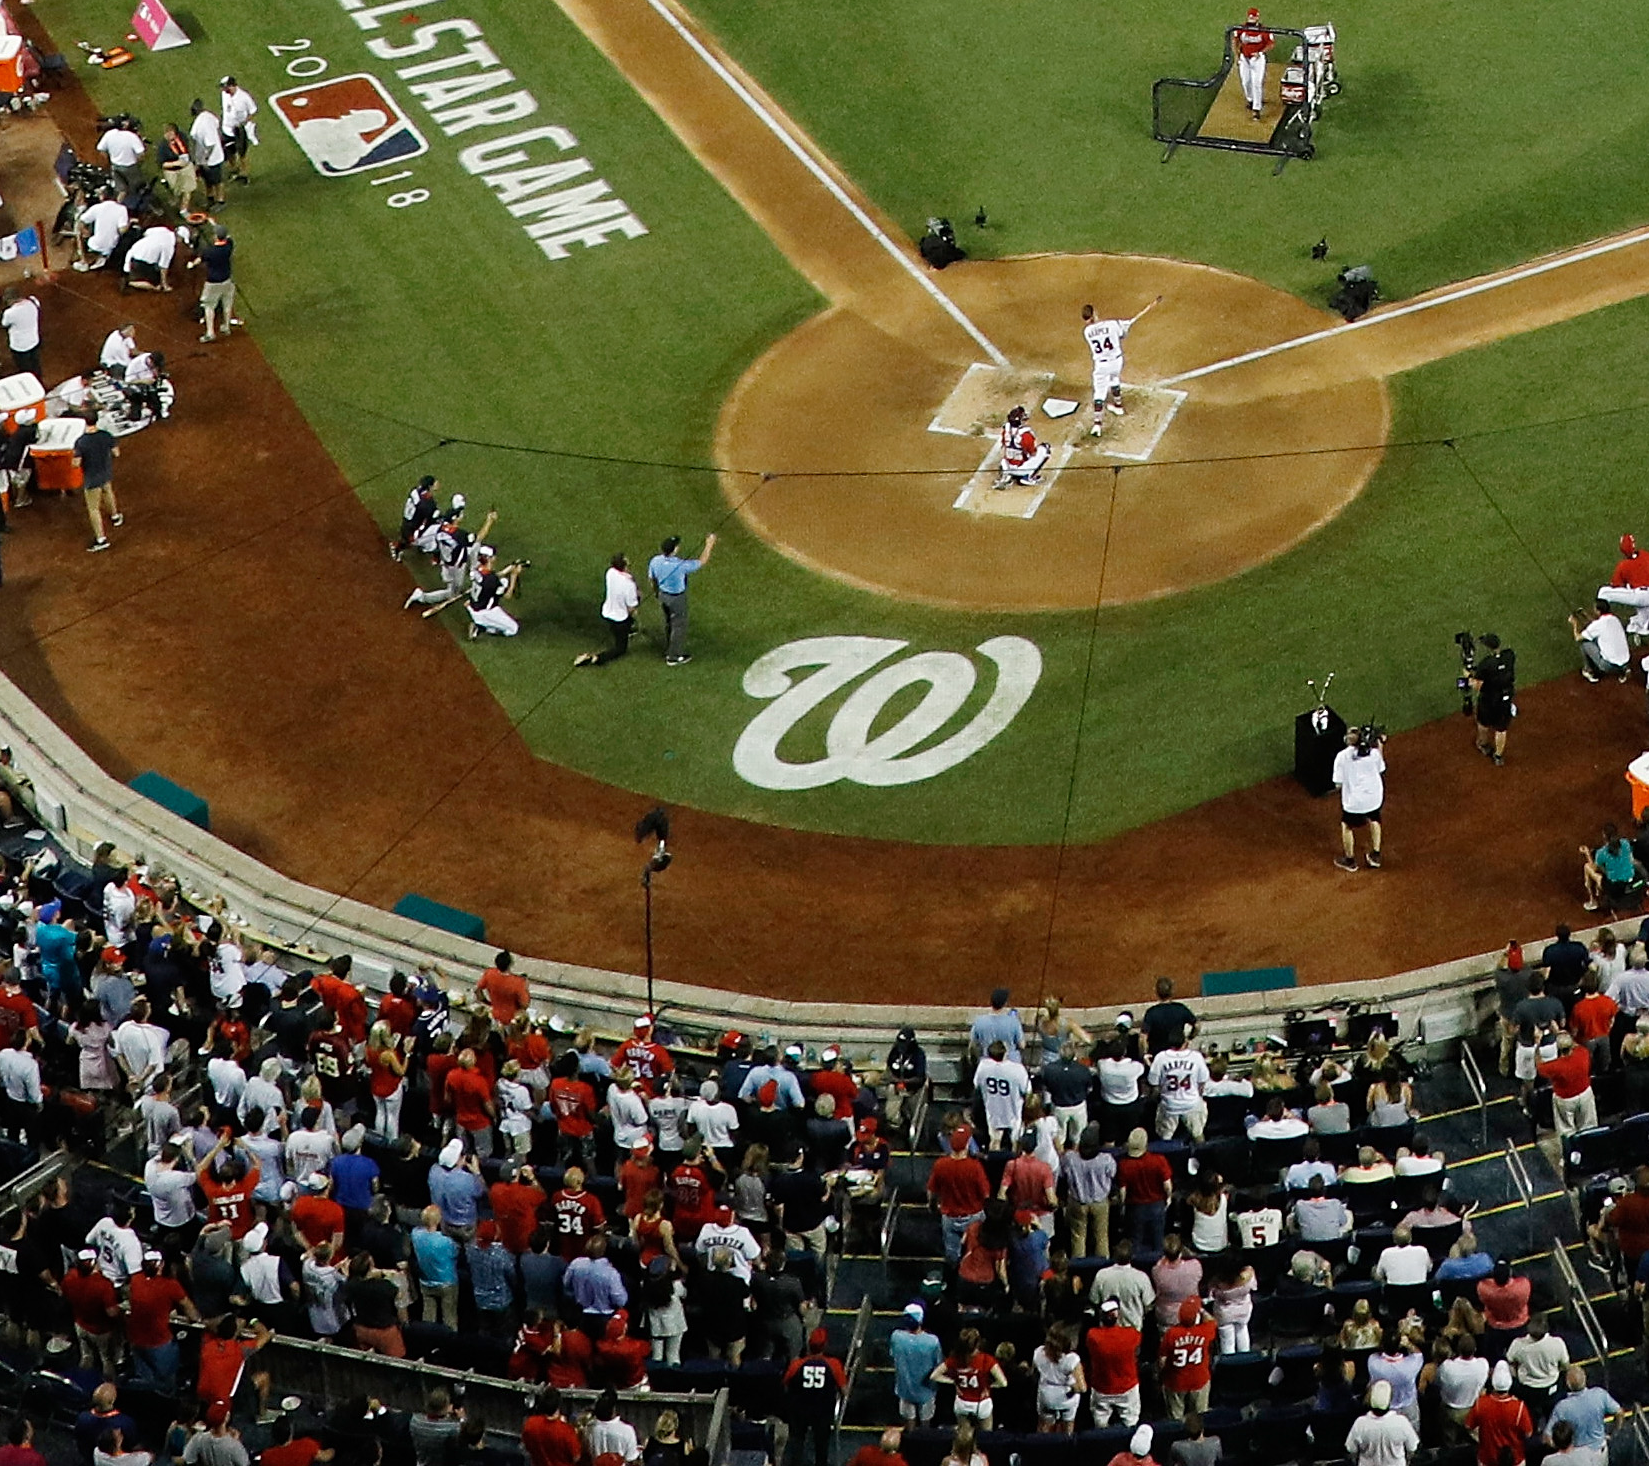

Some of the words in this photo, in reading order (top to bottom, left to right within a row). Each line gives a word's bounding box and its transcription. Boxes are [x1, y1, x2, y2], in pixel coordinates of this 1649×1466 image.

[365, 17, 539, 137] STAR
[459, 124, 650, 262] GAME
[1091, 335, 1114, 355] 34
[732, 633, 1044, 792] W
[985, 1076, 1012, 1098] 99
[1165, 1074, 1193, 1091] 34
[556, 1212, 585, 1236] 34
[1171, 1347, 1203, 1369] 34
[800, 1365, 827, 1390] 55
